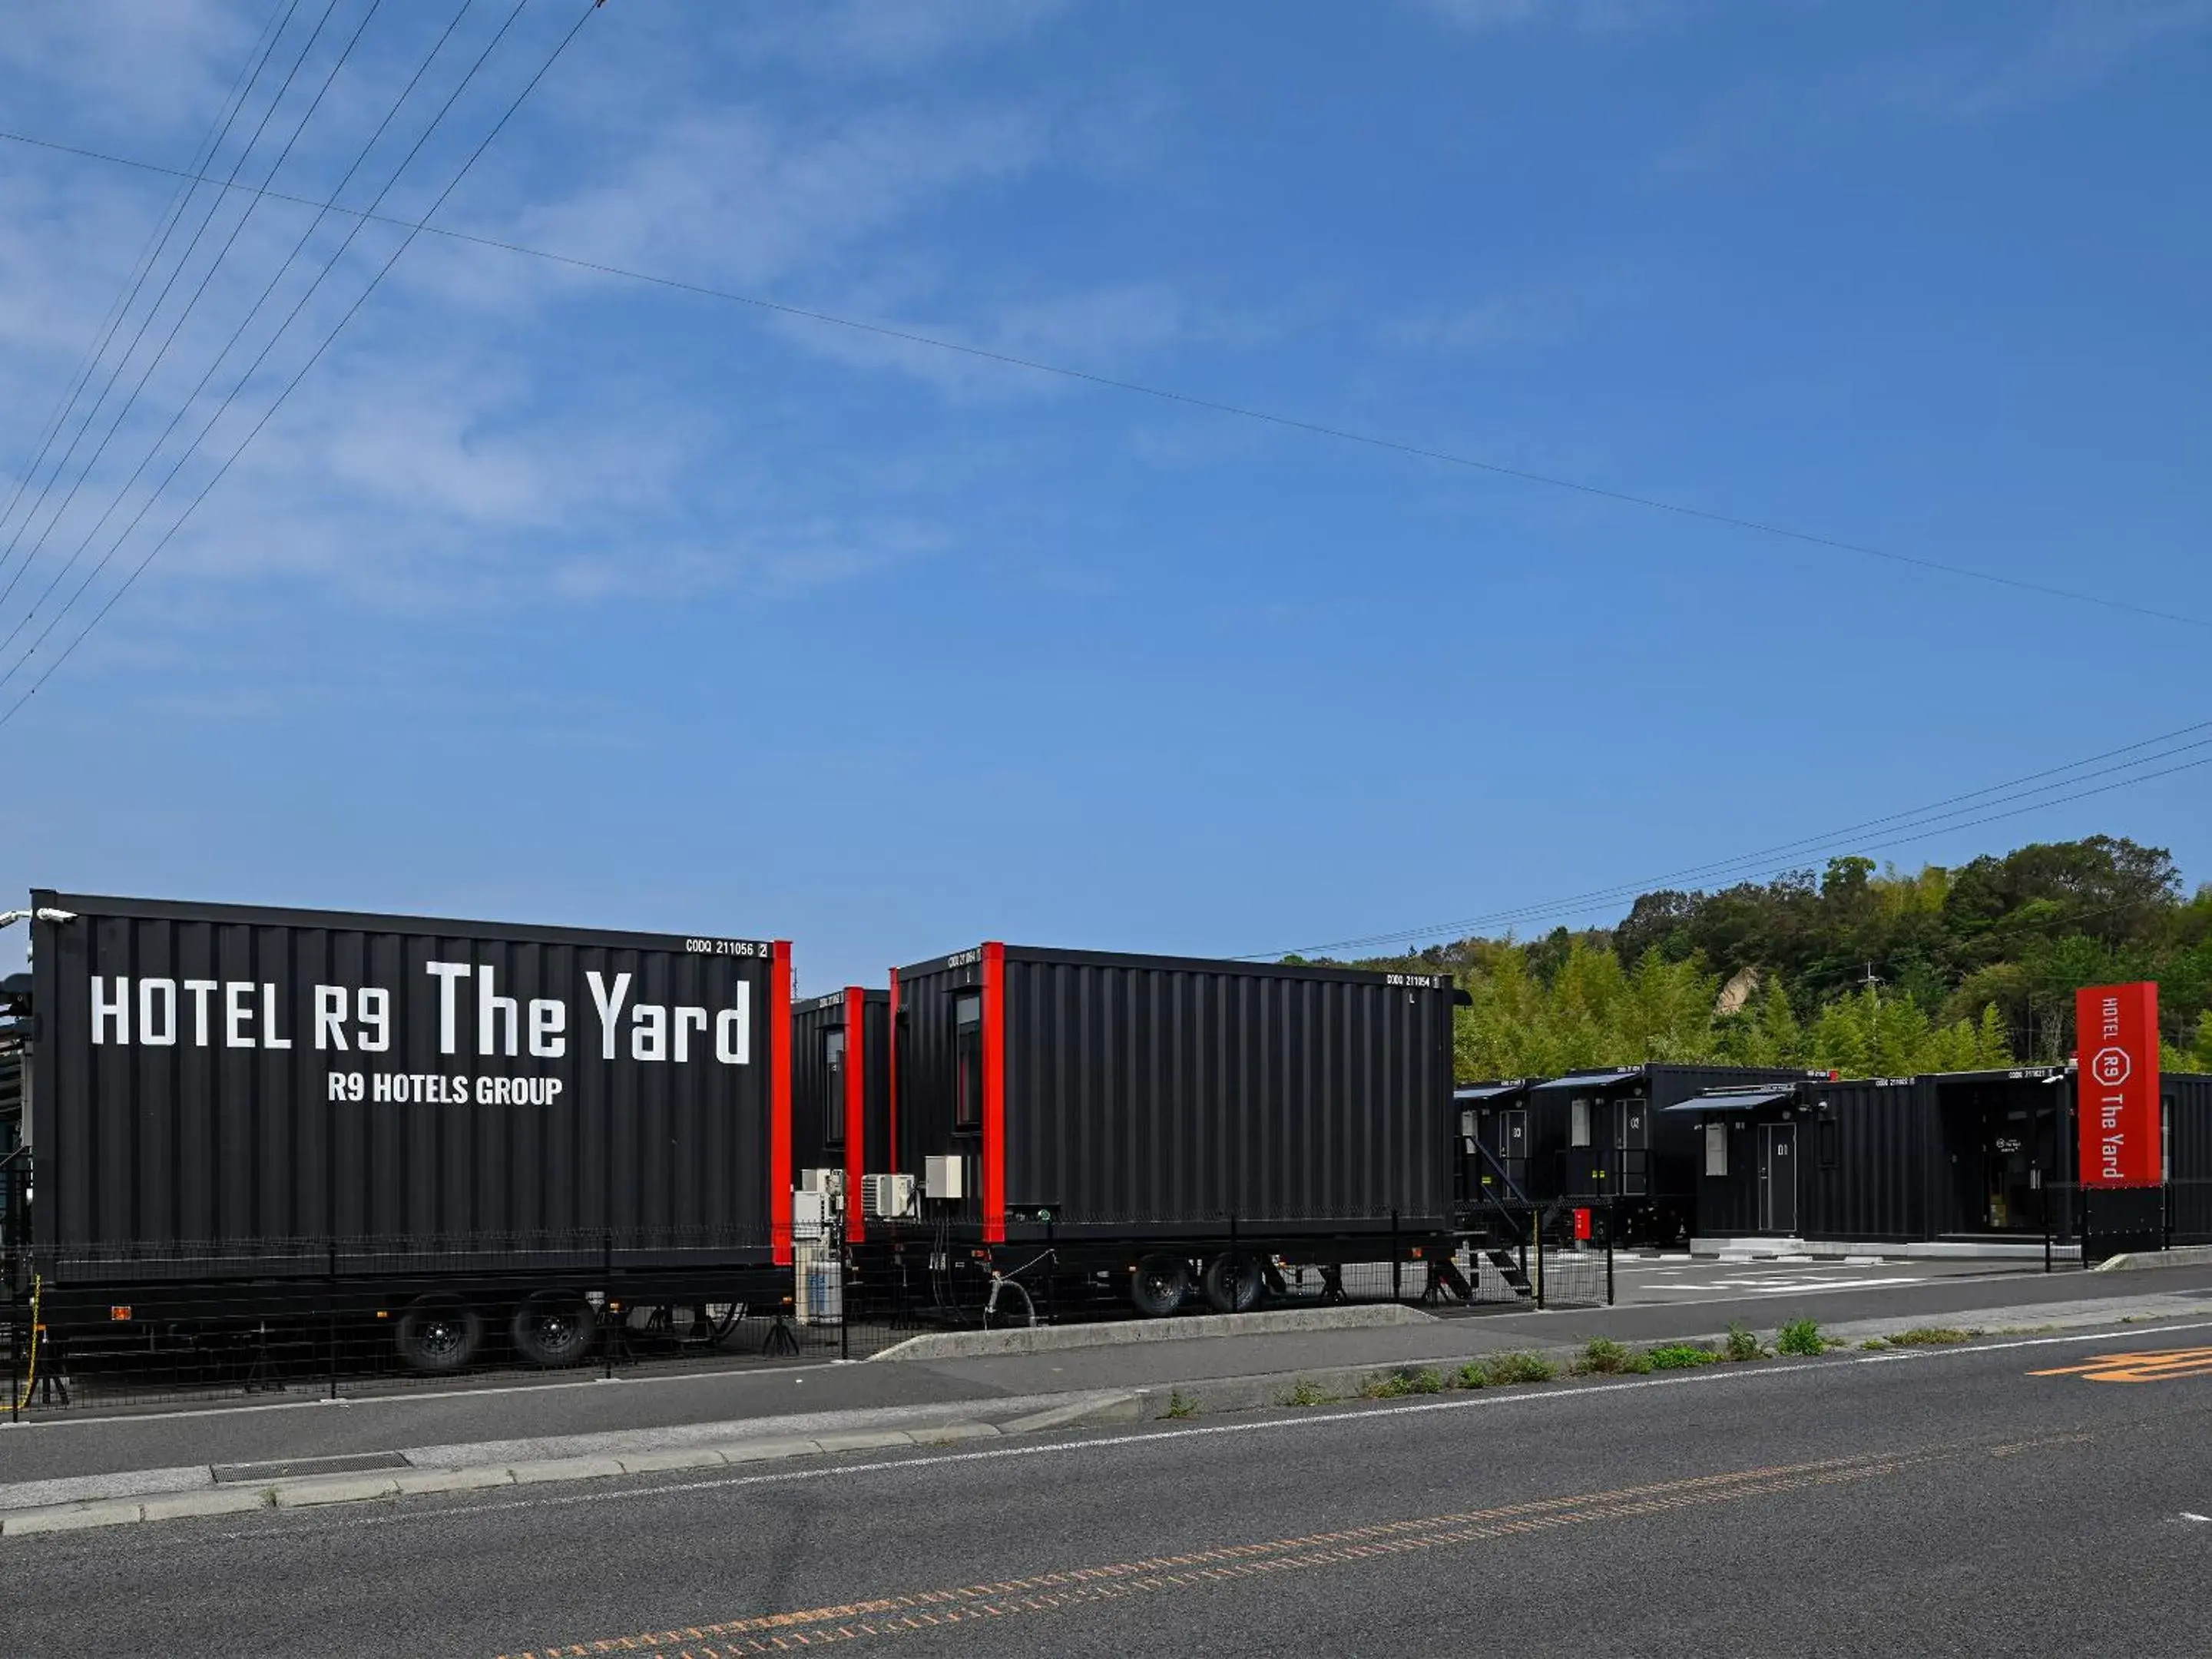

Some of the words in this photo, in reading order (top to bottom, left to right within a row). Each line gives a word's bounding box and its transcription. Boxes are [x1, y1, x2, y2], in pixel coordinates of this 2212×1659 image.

[717, 941, 753, 955] 211056
[91, 976, 291, 1048] HOTEL
[316, 985, 389, 1051] R9
[426, 962, 565, 1057] The
[586, 972, 749, 1064] Yard
[2102, 997, 2118, 1041] HOTEL
[2104, 1056, 2119, 1078] R9
[329, 1072, 364, 1101] R9
[374, 1074, 468, 1103] HOTELS
[476, 1077, 562, 1104] GROUP
[2101, 1093, 2124, 1129] The
[2101, 1133, 2125, 1179] Yard
